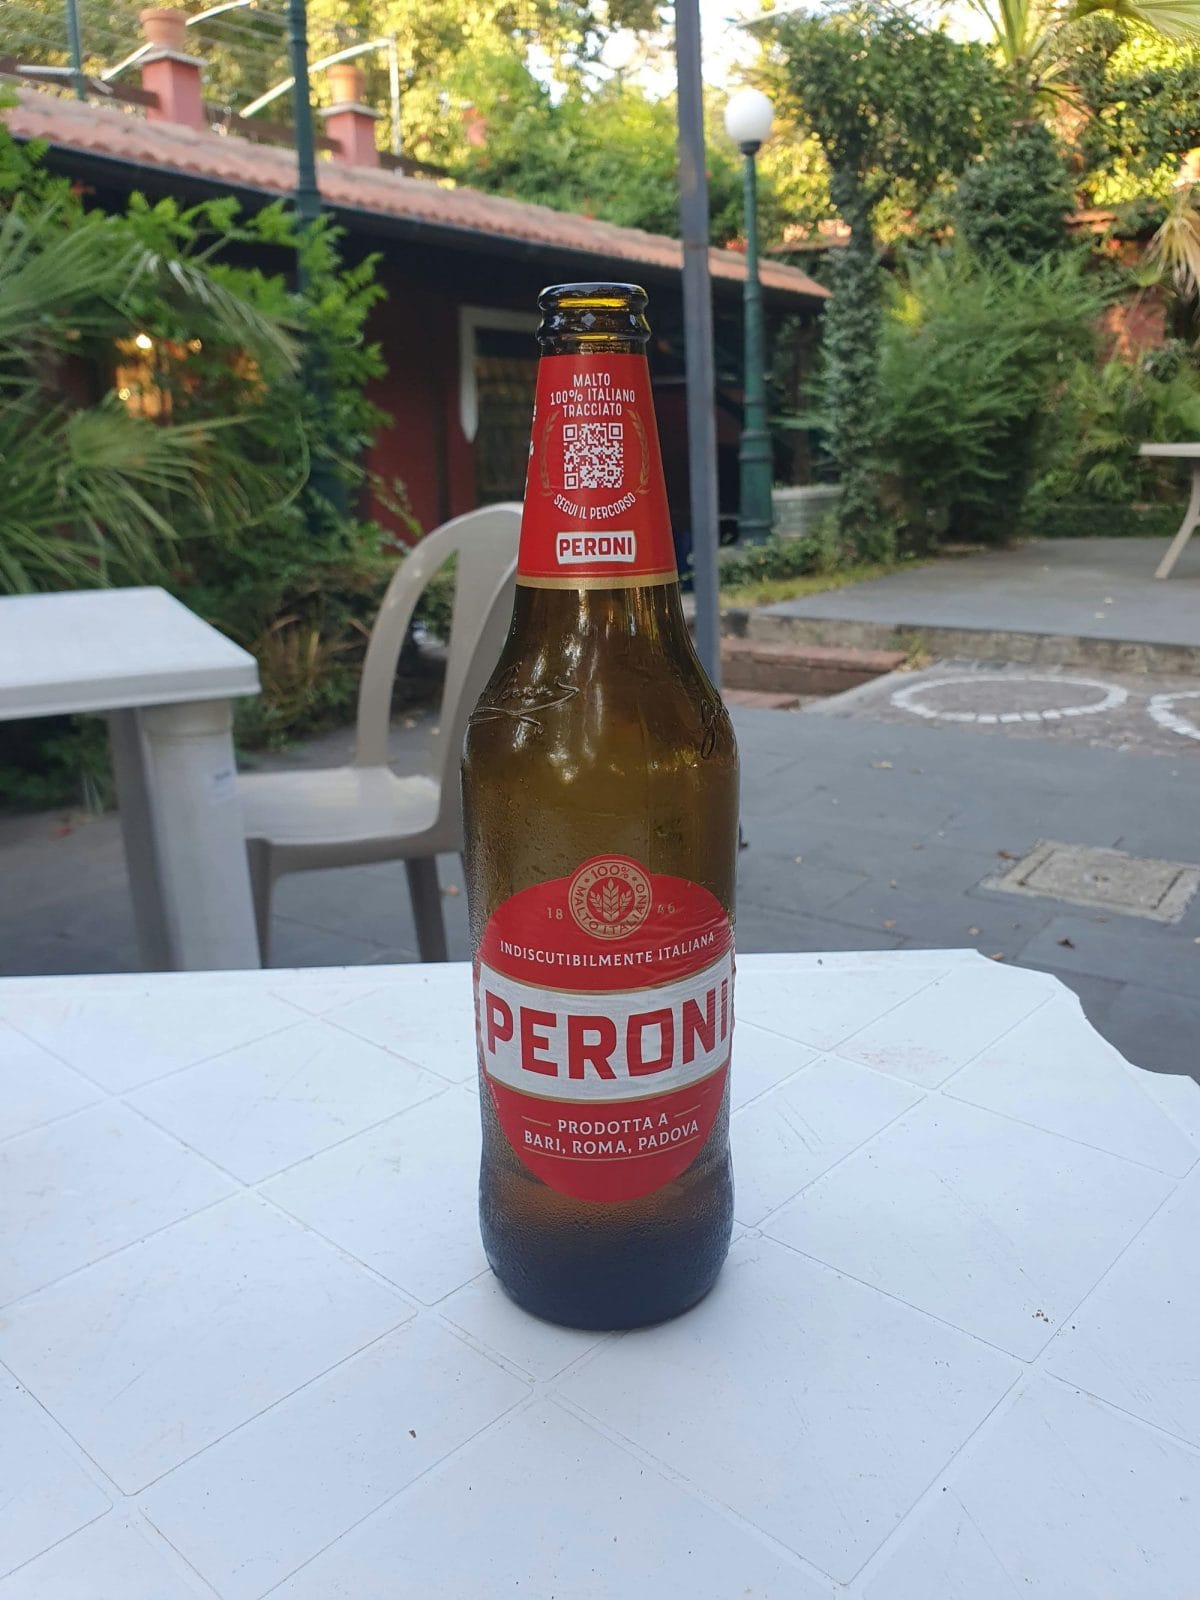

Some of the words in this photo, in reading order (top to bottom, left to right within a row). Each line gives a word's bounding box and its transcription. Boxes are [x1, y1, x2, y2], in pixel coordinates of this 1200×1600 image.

[573, 373, 611, 387] MALTO
[550, 390, 583, 405] 100%
[587, 388, 636, 403] ITALIANO
[562, 403, 622, 418] TRACCIATO
[553, 493, 577, 517] SEGUI
[579, 506, 587, 520] IL
[590, 492, 636, 520] PERCORSO
[559, 536, 632, 557] PERONI
[590, 864, 630, 880] 100%
[575, 886, 599, 931] MALTO
[603, 883, 647, 935] ITALIANO
[500, 940, 653, 967] INDISCUTIBILMENTE
[658, 931, 715, 962] ITALIANA
[485, 978, 728, 1080] PERONI
[558, 1118, 653, 1136] PRODOTTA
[658, 1112, 669, 1126] A
[524, 1130, 566, 1154] BARI,
[572, 1140, 632, 1155] ROMA,
[638, 1119, 700, 1151] PADOVA
